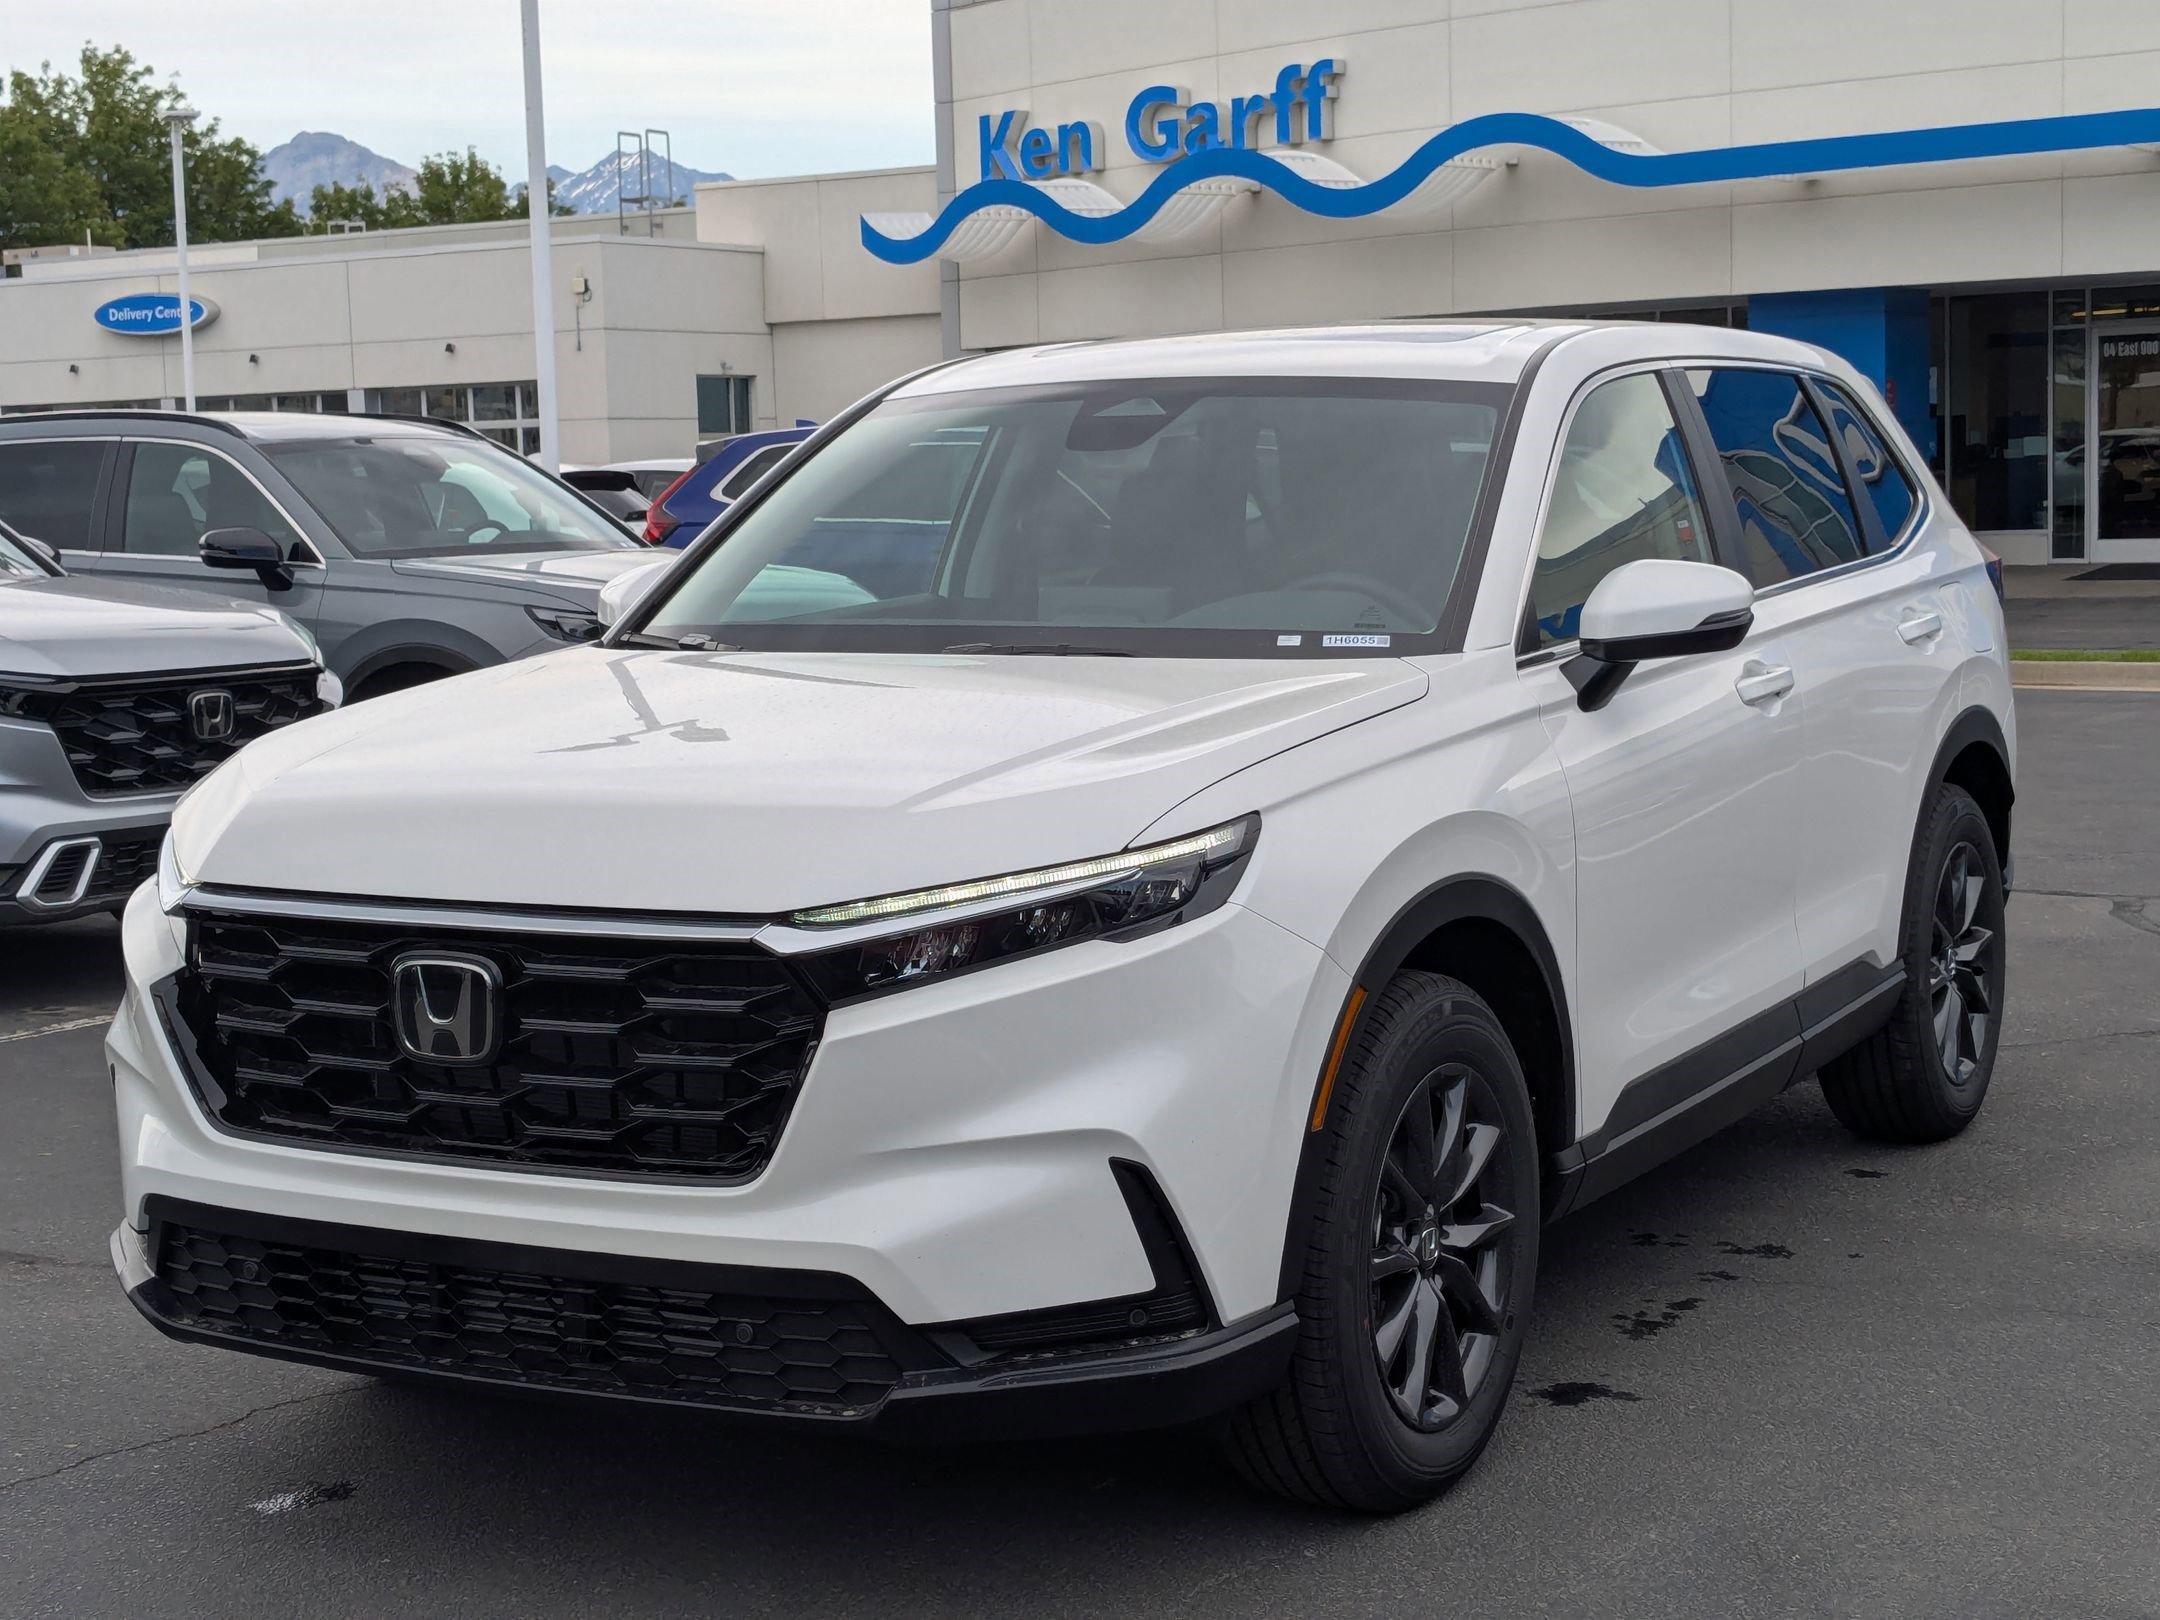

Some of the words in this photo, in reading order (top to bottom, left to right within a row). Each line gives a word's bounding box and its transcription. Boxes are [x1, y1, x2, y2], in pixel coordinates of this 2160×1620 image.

[979, 110, 1103, 181] Ken
[1125, 59, 1344, 163] Garff
[109, 307, 153, 322] Delivery
[155, 305, 193, 319] Cent
[2117, 341, 2138, 356] East
[1326, 636, 1376, 645] 1H6055
